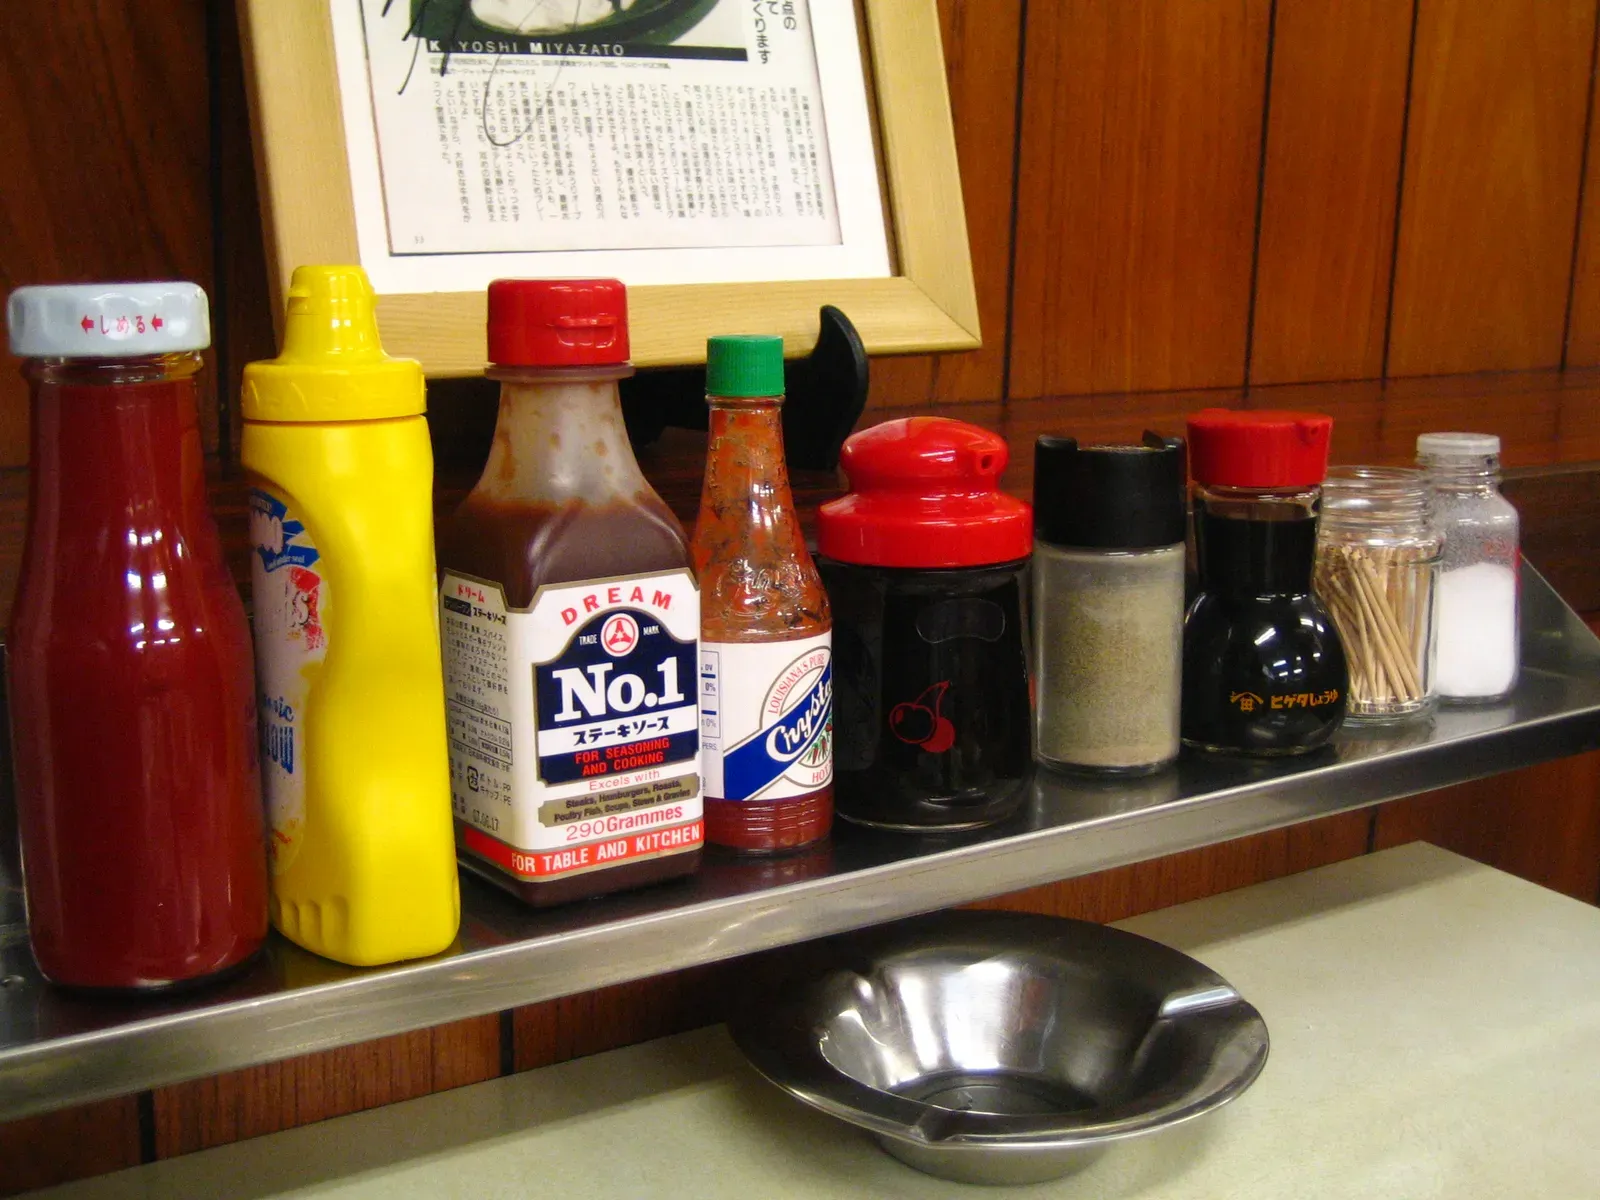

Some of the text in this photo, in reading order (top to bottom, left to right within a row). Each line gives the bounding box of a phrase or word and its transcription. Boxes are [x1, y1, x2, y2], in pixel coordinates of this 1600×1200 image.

[752, 0, 772, 65] くります
[429, 39, 625, 56] KYOSHI MIYAZATO
[100, 314, 146, 335] しめる
[456, 583, 486, 603] ドリーム
[560, 586, 672, 626] DREAM
[579, 624, 660, 645] TRADE MARK
[551, 656, 685, 722] No.1
[1270, 688, 1340, 710] ヒゲタしょうゆ
[572, 716, 670, 747] ステーキソース
[575, 737, 670, 765] FOR SEASONING
[582, 751, 664, 777] AND COOKING
[588, 769, 660, 792] Excels with
[511, 824, 701, 873] FOR TABLE AND KITCHEN
